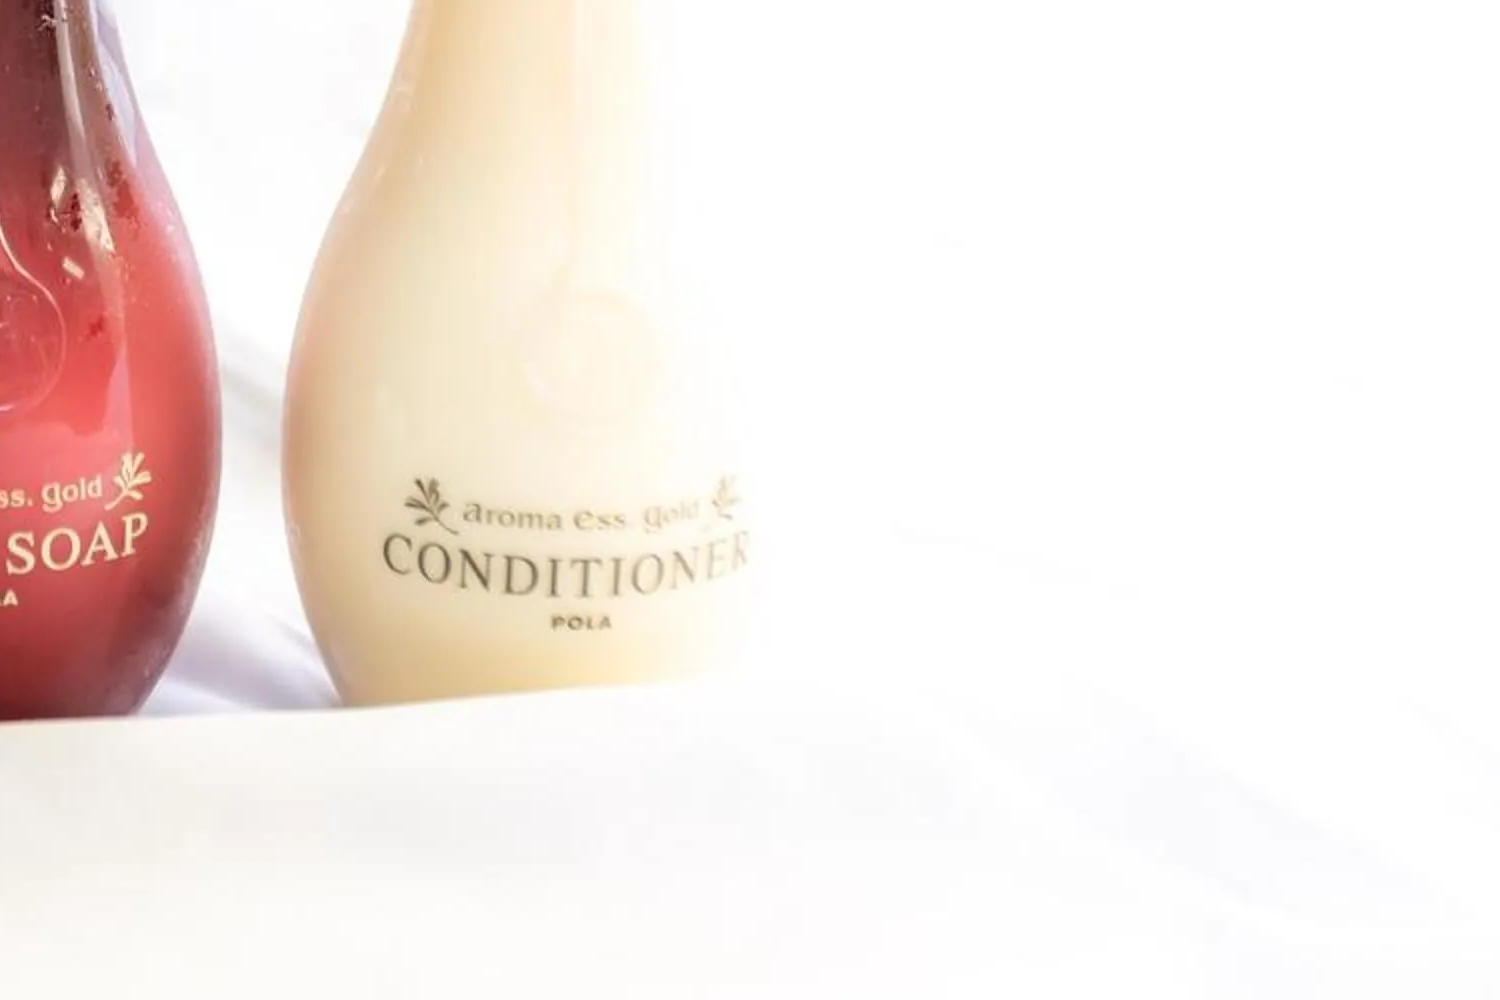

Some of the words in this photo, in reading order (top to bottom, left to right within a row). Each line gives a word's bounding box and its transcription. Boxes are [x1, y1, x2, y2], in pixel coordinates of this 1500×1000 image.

[41, 475, 103, 513] gold
[463, 501, 563, 531] aroma
[643, 500, 702, 535] gold
[6, 511, 149, 576] SOAP
[382, 530, 751, 600] CONDITIONER
[551, 614, 613, 632] POLA
